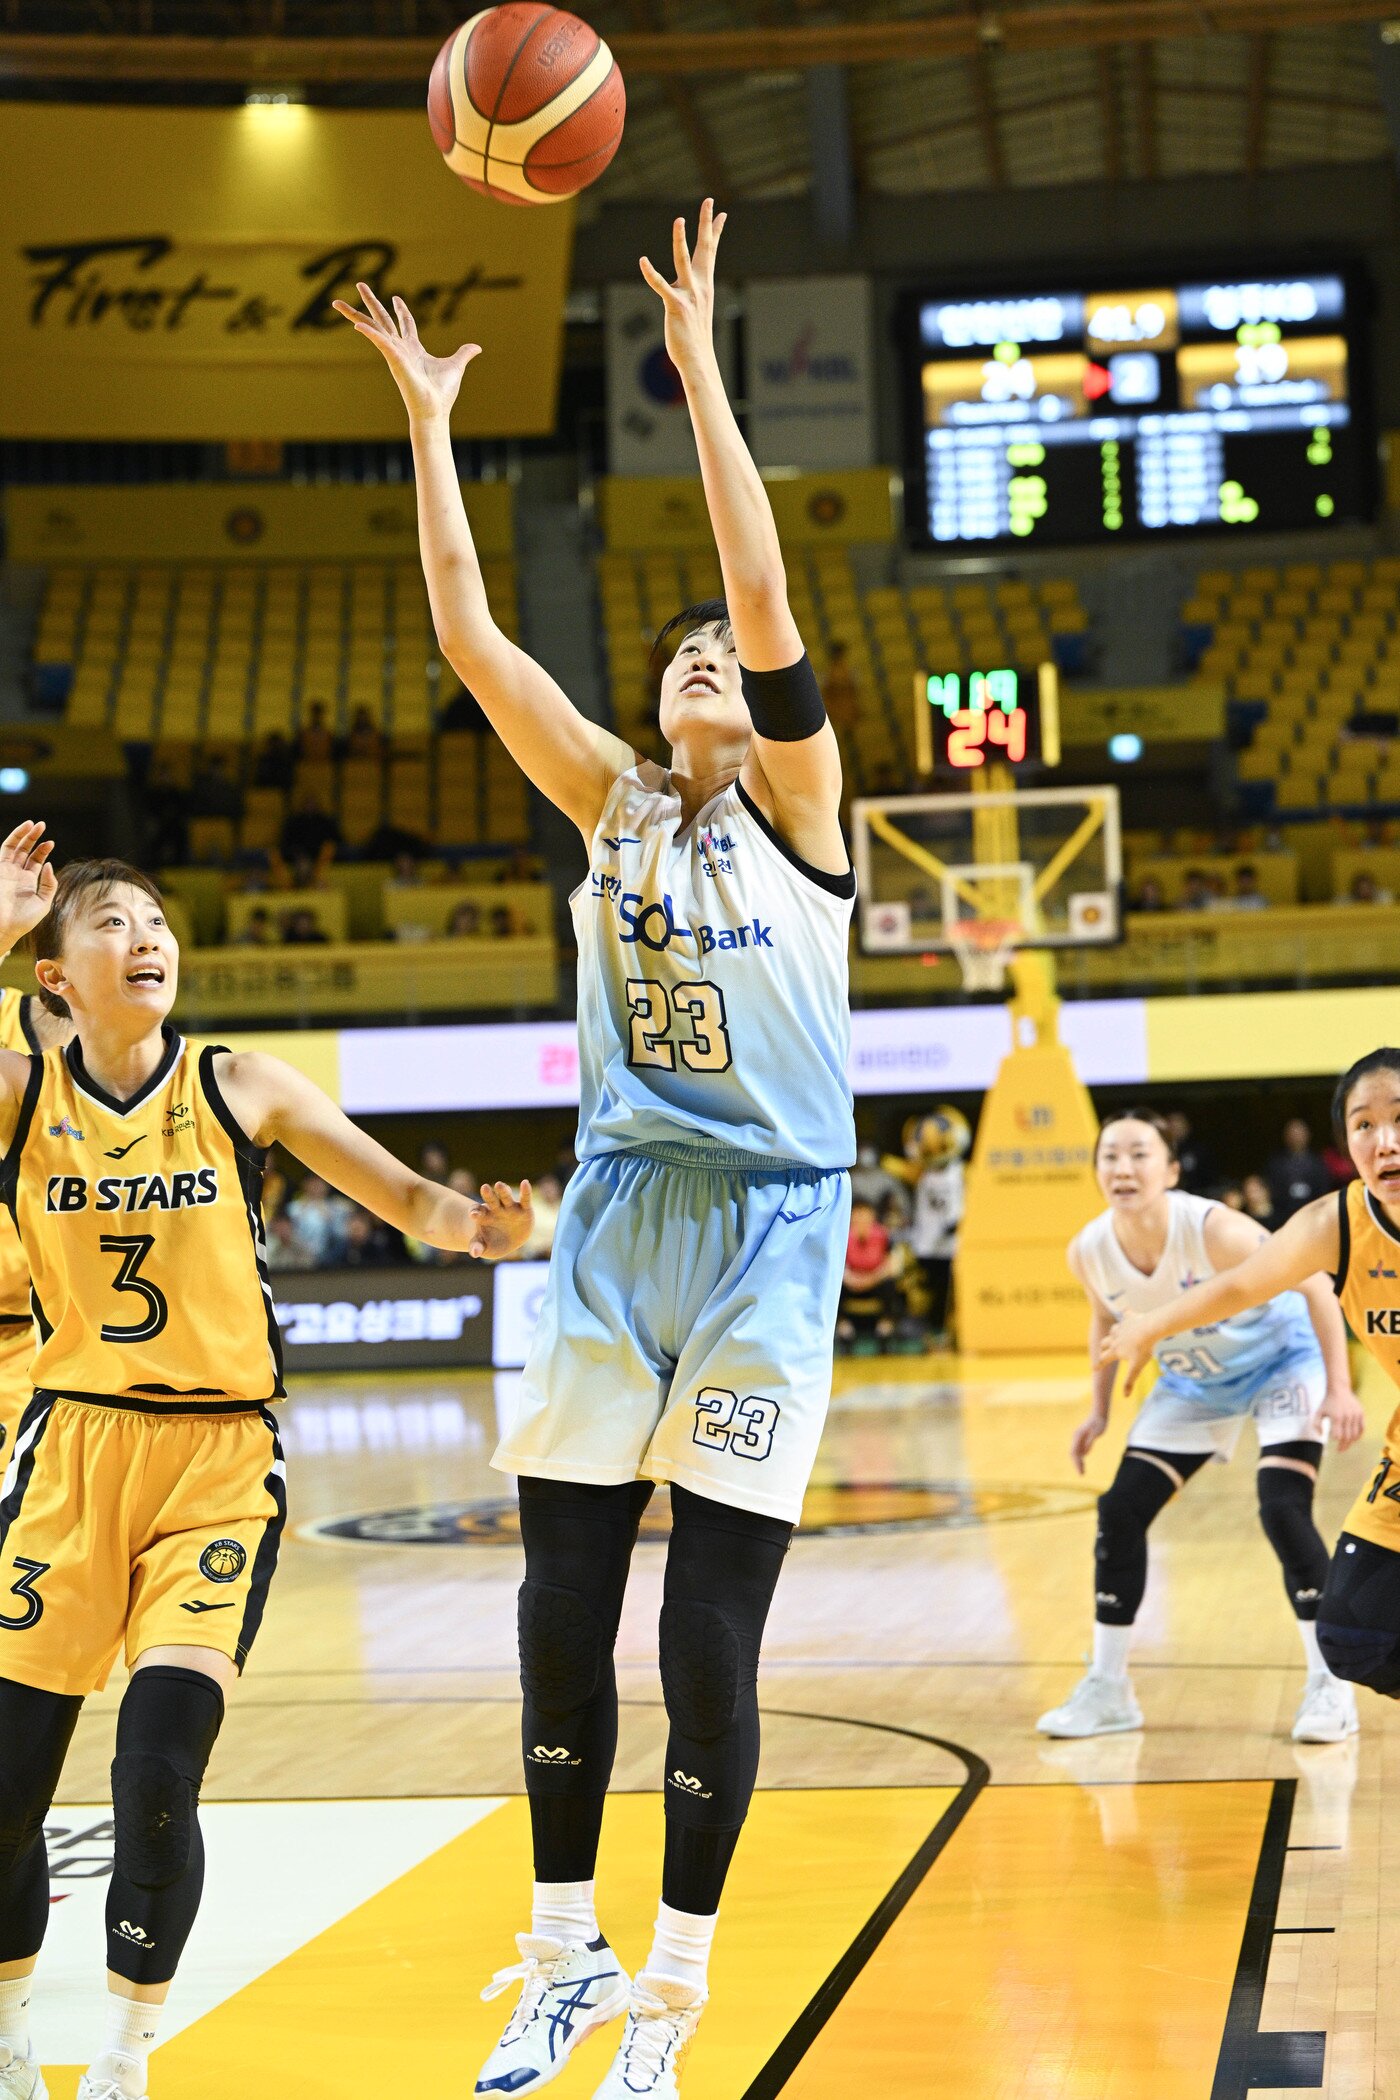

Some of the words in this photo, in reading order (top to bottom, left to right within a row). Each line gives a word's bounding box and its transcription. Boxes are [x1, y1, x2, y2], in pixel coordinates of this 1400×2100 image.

[948, 707, 1026, 767] 24
[702, 858, 733, 878] 인천
[619, 893, 692, 951] SOL
[698, 918, 774, 955] Bank
[625, 978, 733, 1073] 23
[46, 1176, 88, 1212] KB
[96, 1168, 218, 1212] STARS
[100, 1234, 168, 1343] 3
[1159, 1346, 1227, 1381] 21
[692, 1386, 780, 1462] 23
[1271, 1384, 1310, 1418] 21
[0, 1556, 51, 1631] 3
